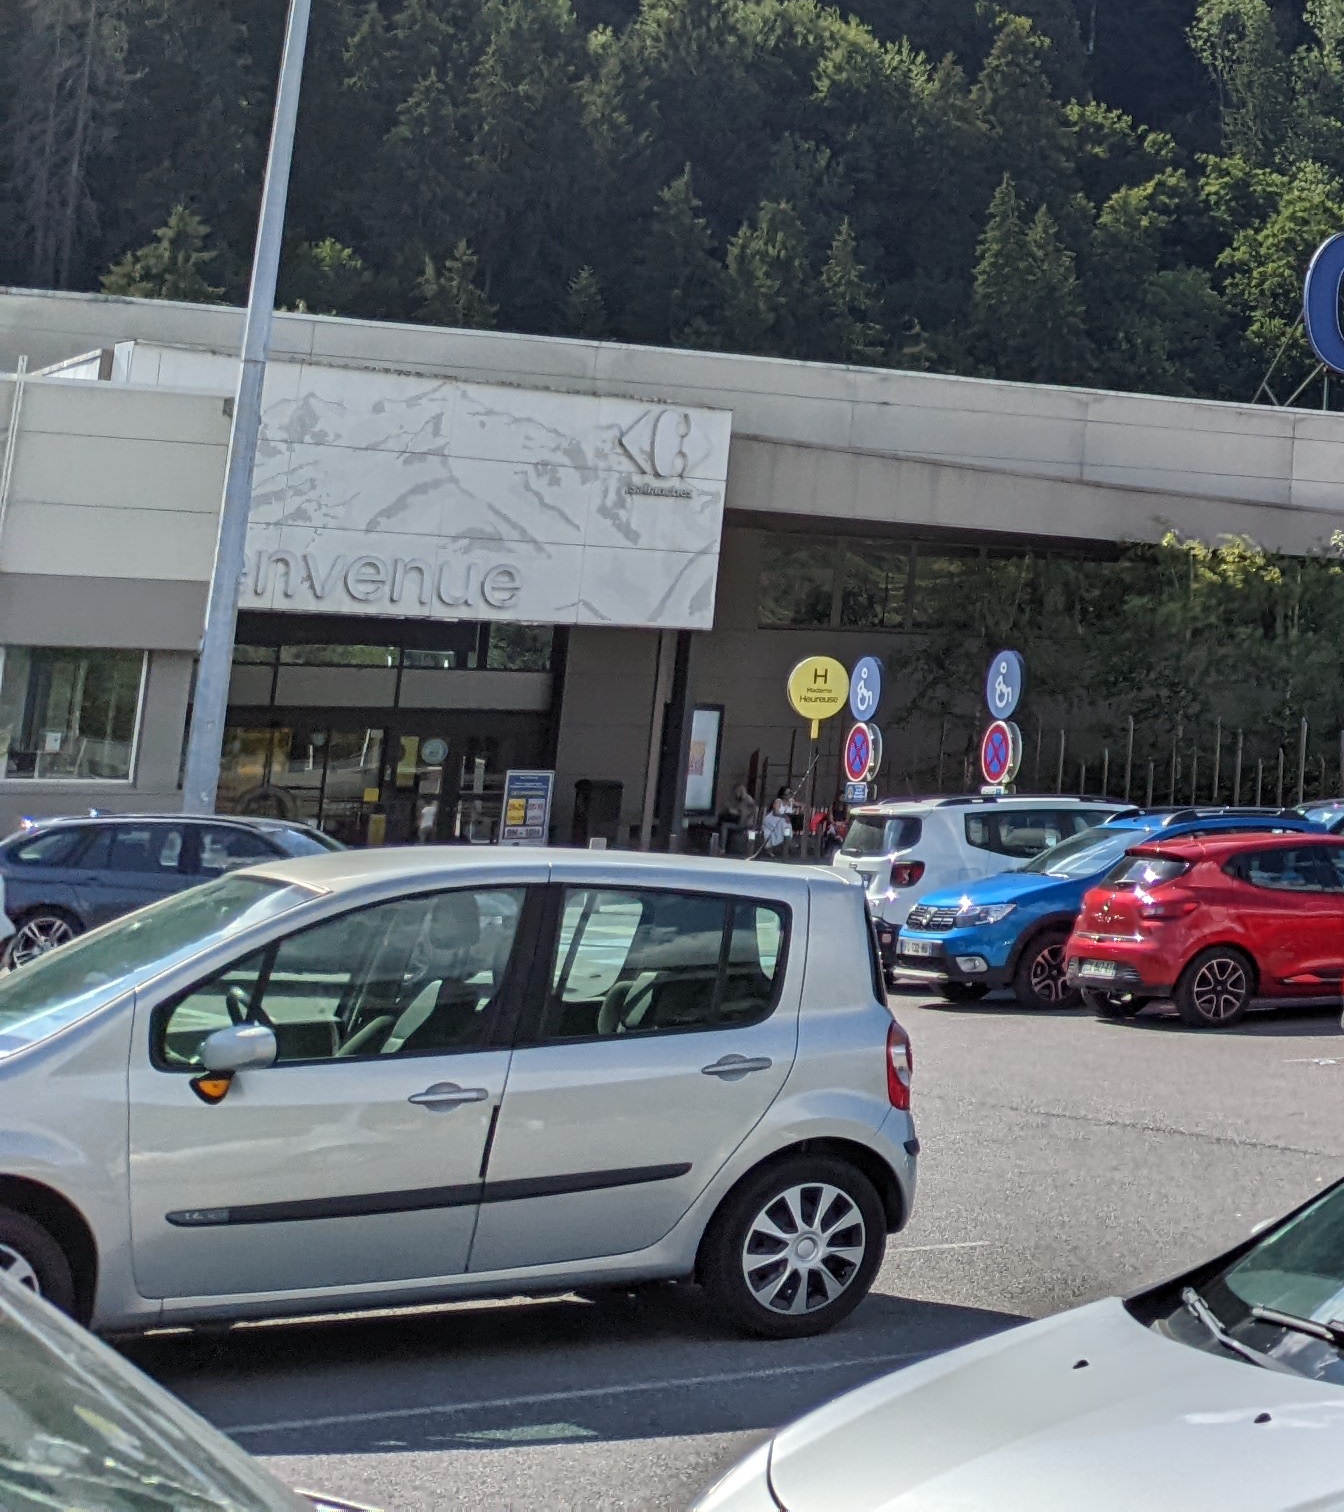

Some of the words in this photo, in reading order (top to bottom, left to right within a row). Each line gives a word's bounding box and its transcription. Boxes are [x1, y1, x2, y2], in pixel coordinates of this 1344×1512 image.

[240, 549, 523, 609] nvenue
[813, 668, 828, 684] H
[799, 695, 838, 703] Heureuse
